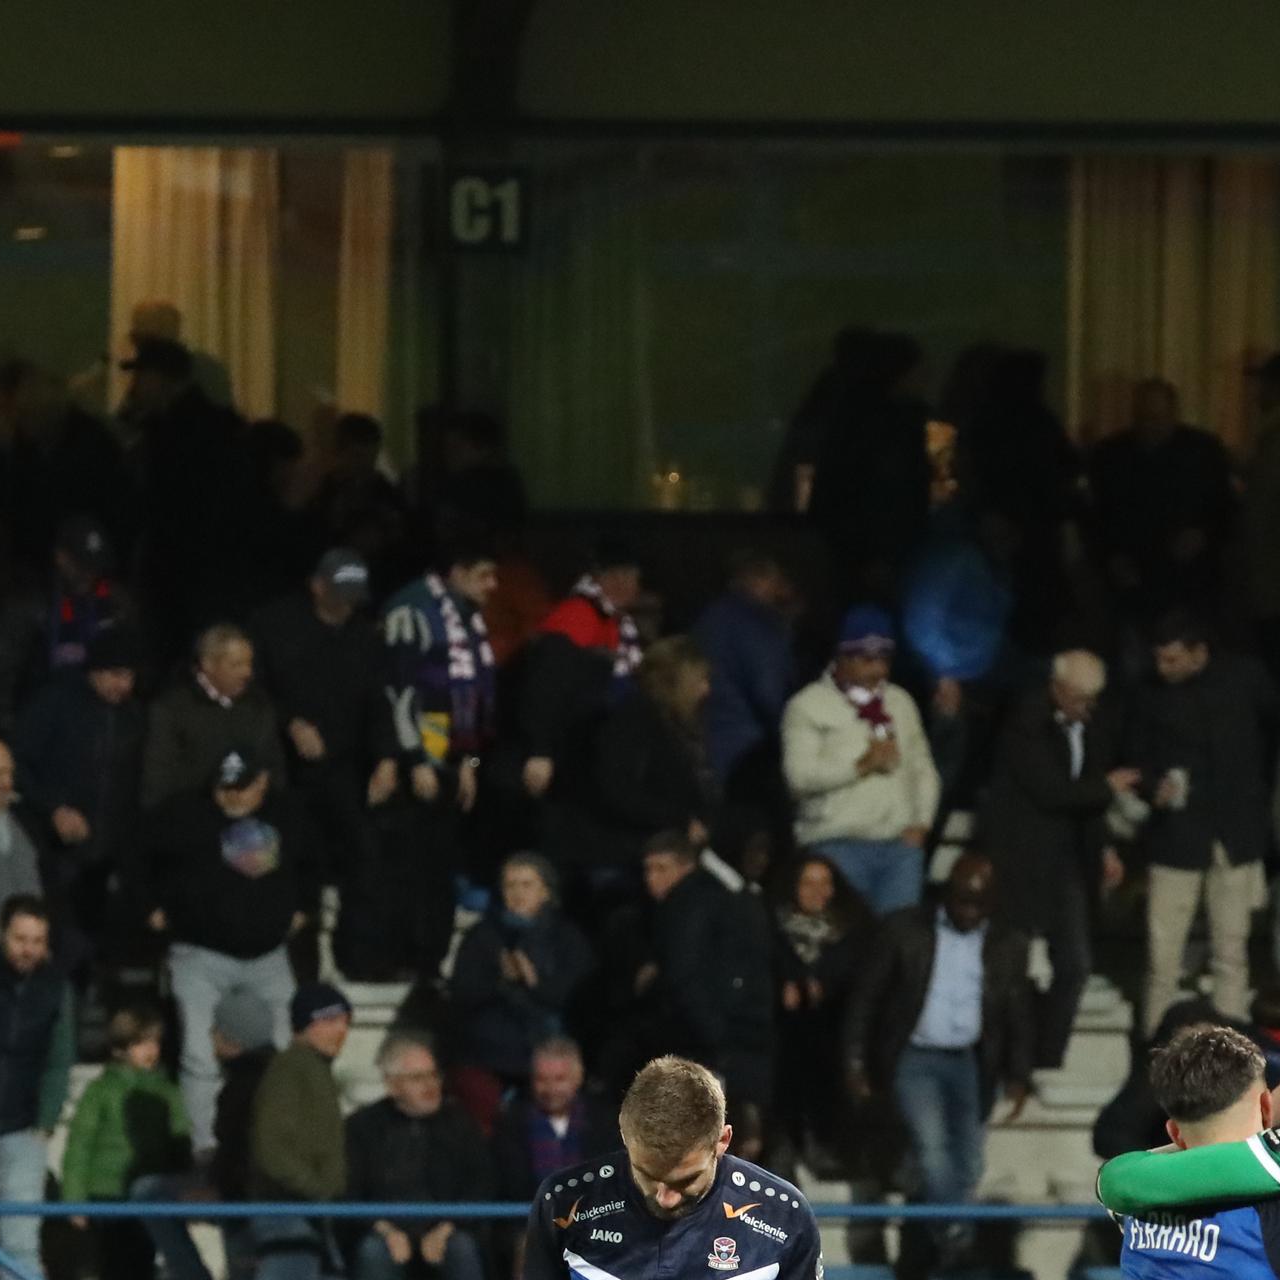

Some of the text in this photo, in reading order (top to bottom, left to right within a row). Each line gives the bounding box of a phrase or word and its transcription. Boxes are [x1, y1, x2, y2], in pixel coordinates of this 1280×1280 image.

[451, 178, 519, 241] C1
[571, 1200, 626, 1222] Valckenier
[590, 1229, 623, 1243] JAKO
[739, 1211, 789, 1241] Valckenier
